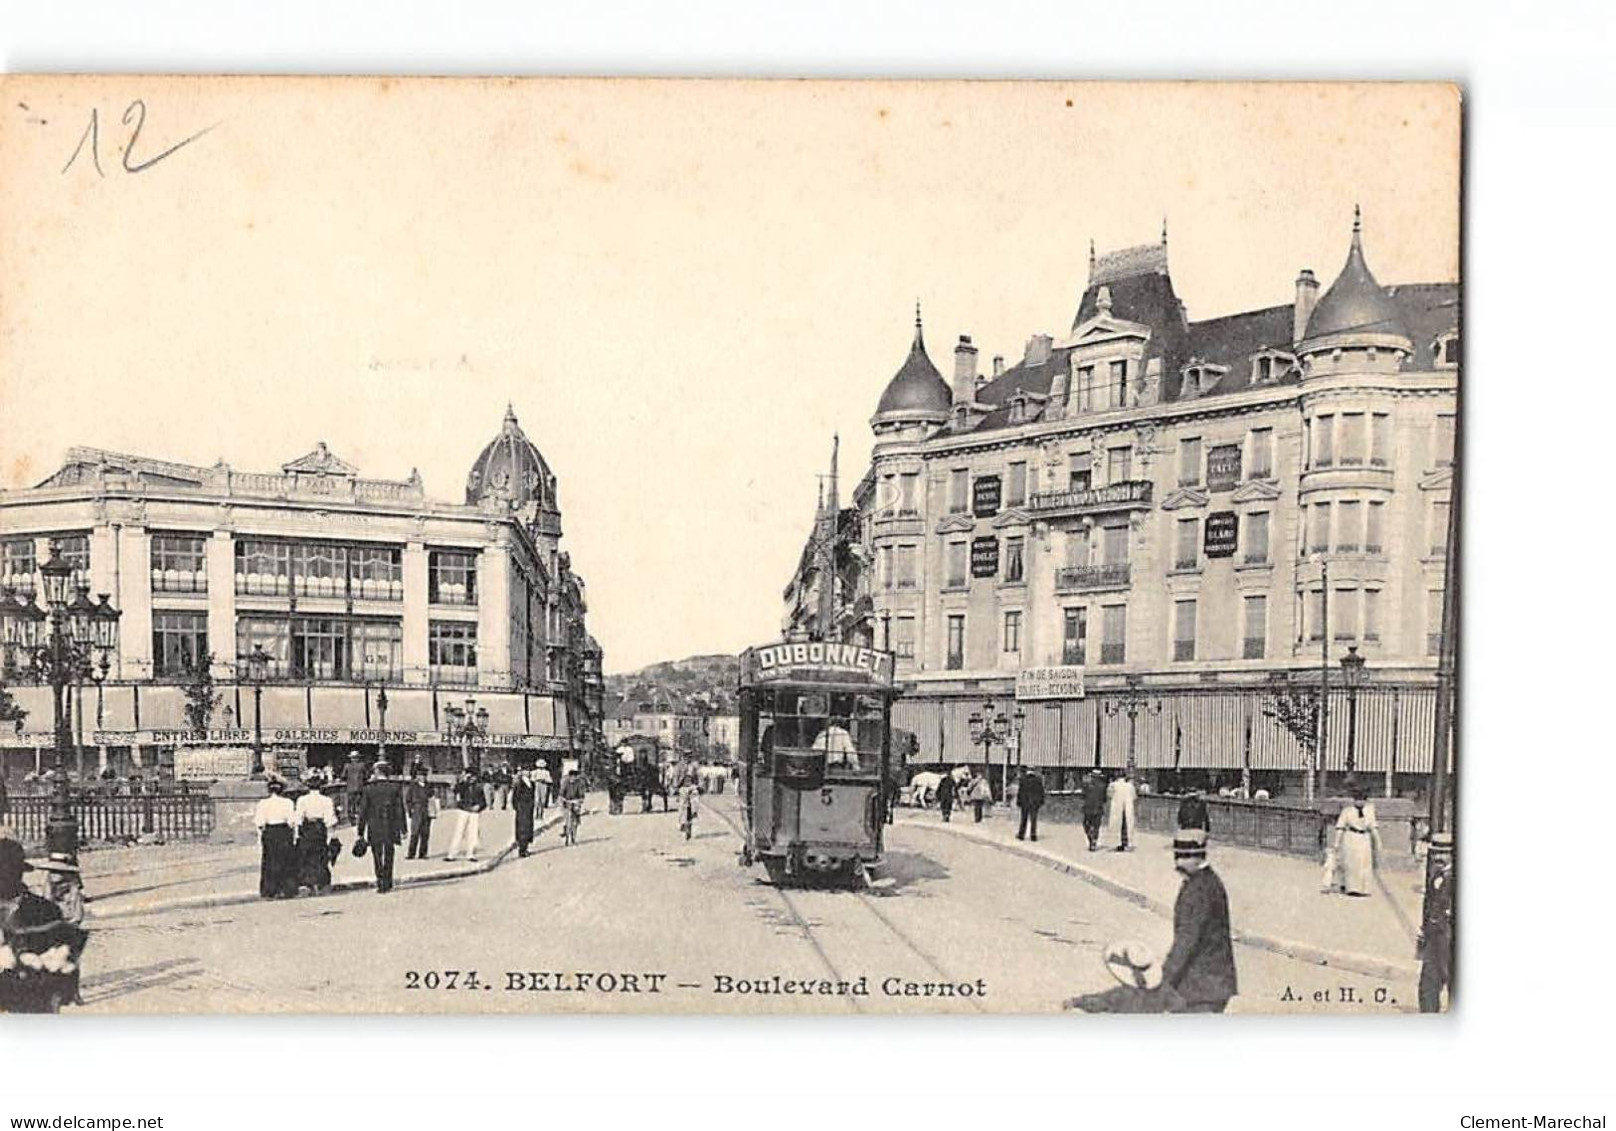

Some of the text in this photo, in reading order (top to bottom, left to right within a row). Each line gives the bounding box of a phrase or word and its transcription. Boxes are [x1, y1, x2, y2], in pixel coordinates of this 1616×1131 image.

[62, 98, 223, 177] 12
[759, 643, 889, 671] DUBONNET
[1036, 669, 1046, 681] DE
[1048, 668, 1078, 680] SAISON
[210, 730, 250, 741] LIBRE
[275, 730, 339, 741] GALERIES
[821, 788, 832, 806] 5
